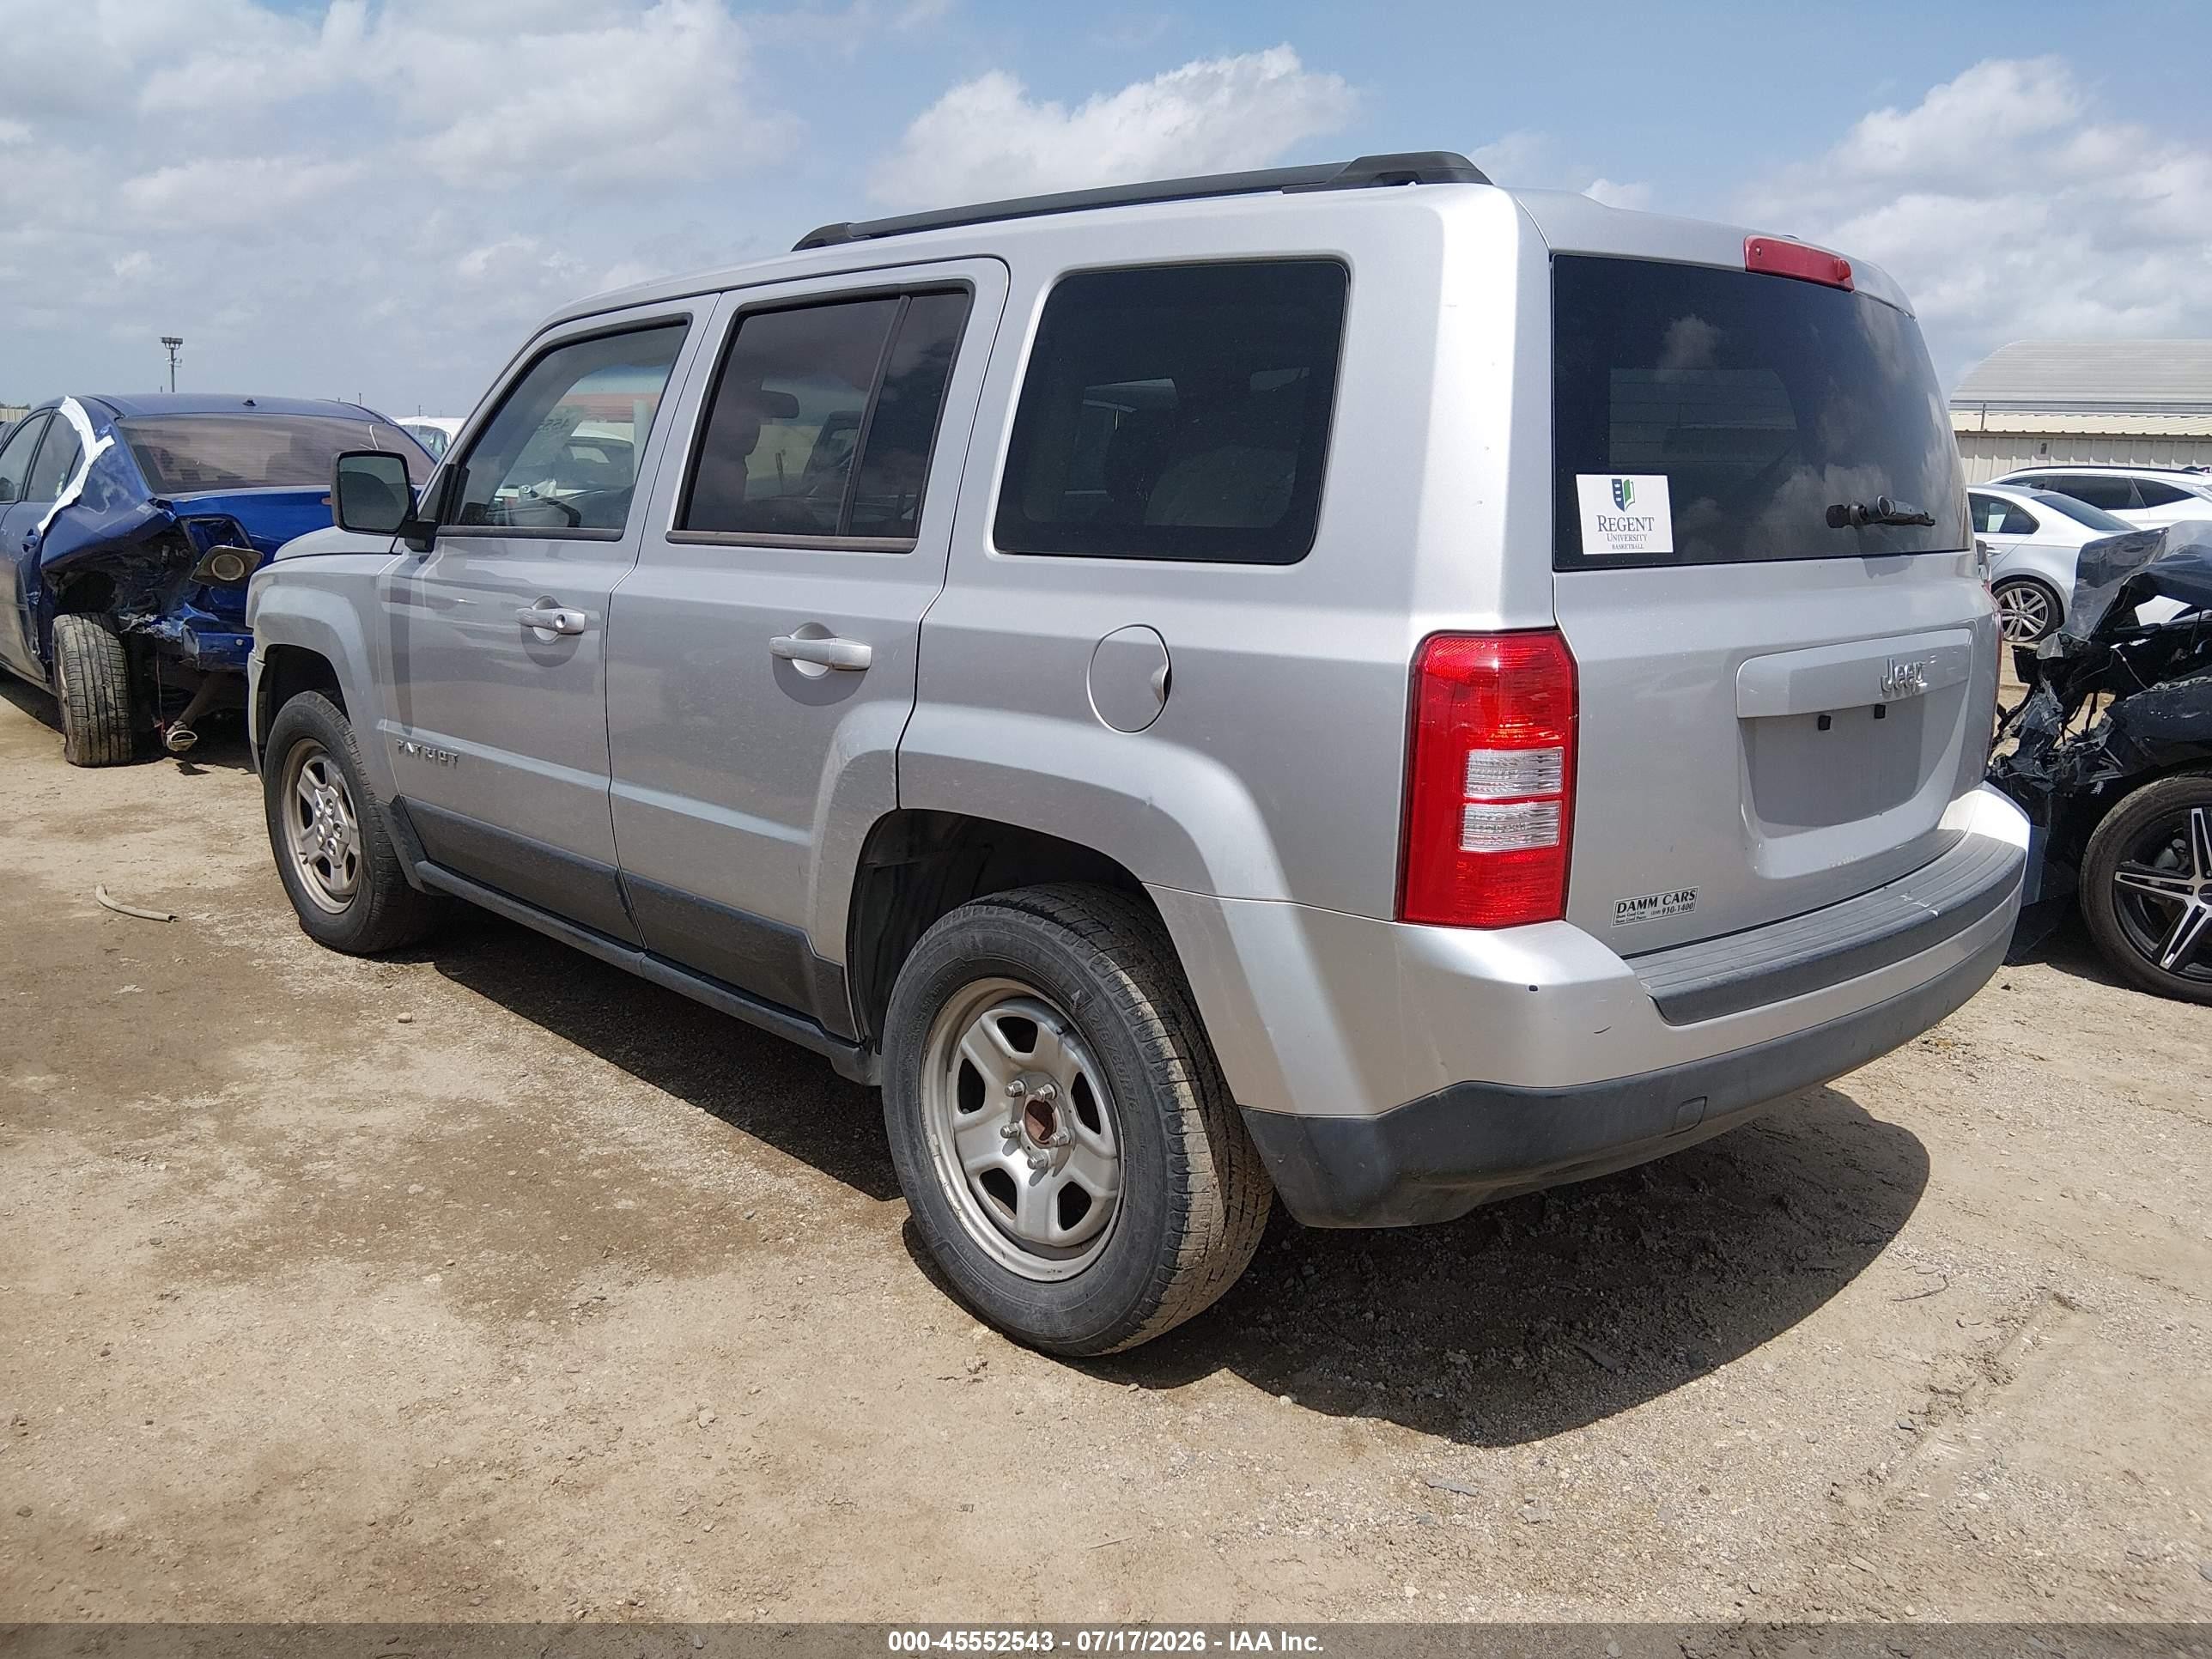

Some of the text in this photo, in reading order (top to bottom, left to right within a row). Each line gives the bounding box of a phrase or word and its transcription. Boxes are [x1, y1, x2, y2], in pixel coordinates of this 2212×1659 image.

[1596, 515, 1655, 532] REGENT
[1607, 533, 1647, 542] UNIVERSITY
[1881, 658, 1926, 694] Jeep
[396, 738, 459, 763] PATRIOT
[1616, 890, 1696, 914] DAMM CARS
